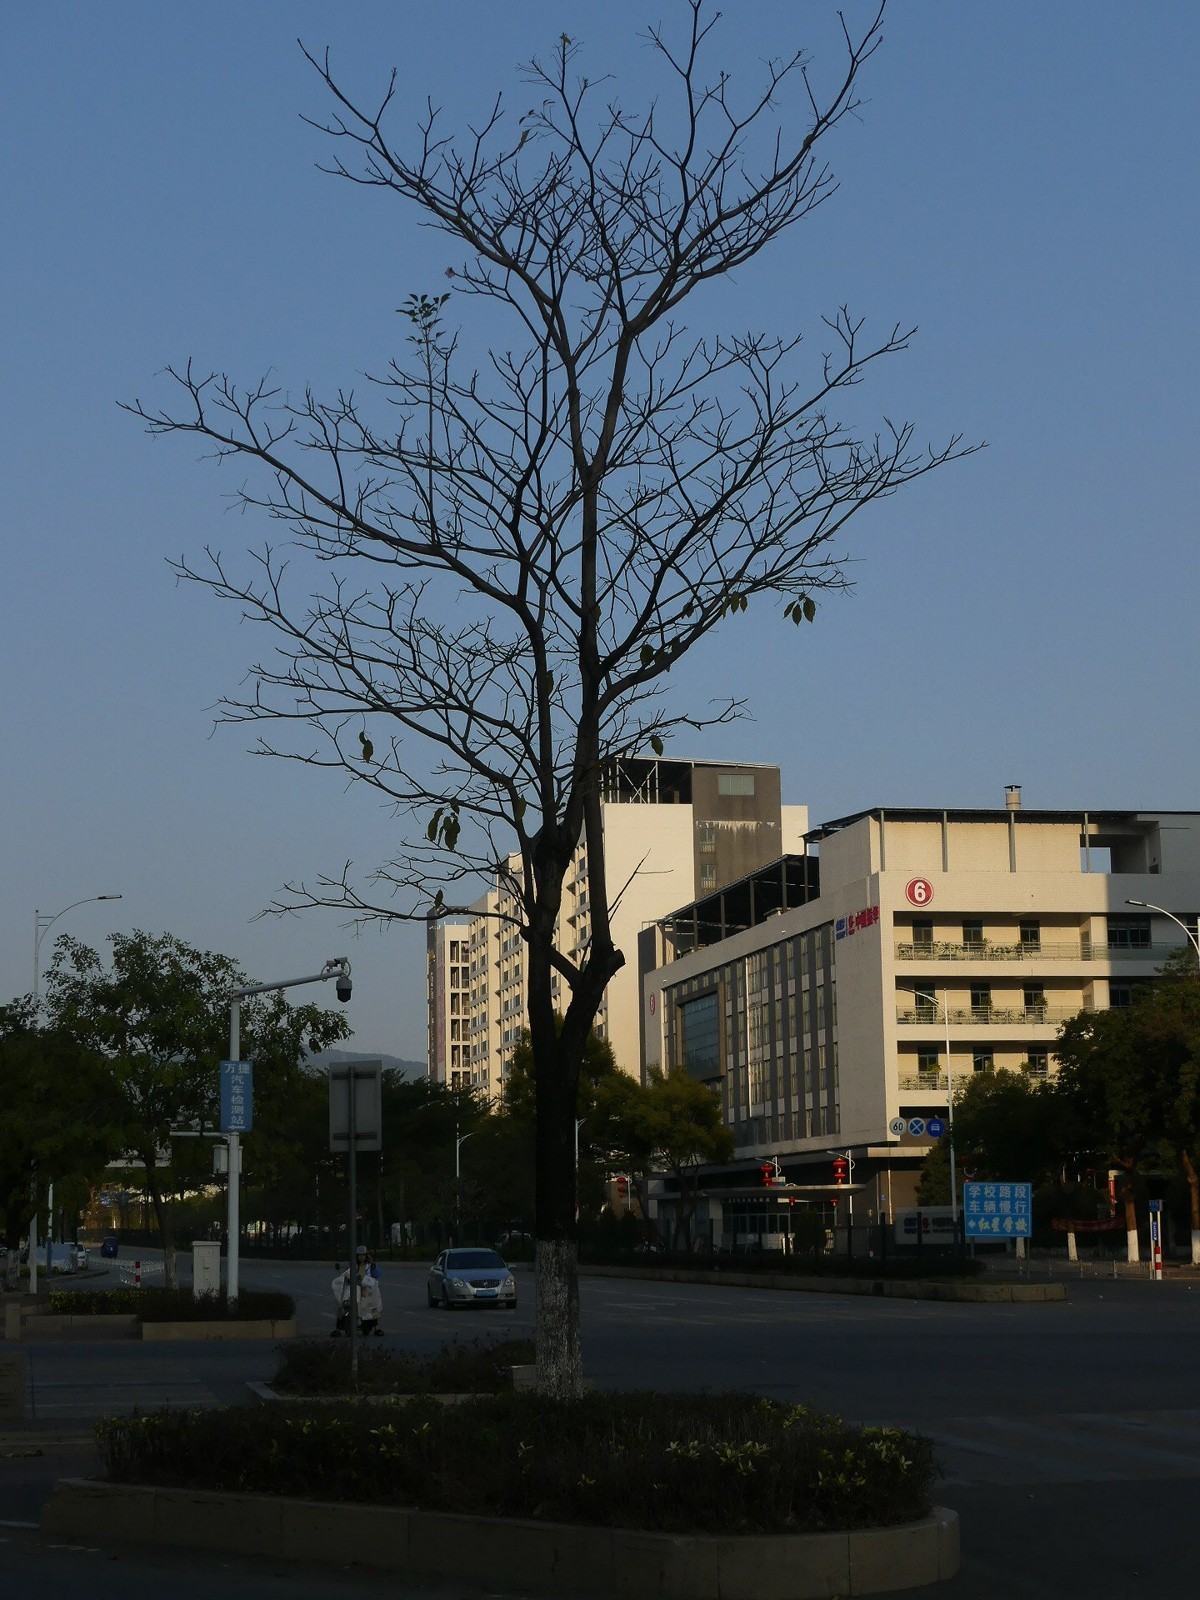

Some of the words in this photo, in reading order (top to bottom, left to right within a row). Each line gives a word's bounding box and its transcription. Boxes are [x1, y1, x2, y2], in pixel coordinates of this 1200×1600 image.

[914, 881, 926, 902] 6
[224, 1063, 251, 1074] 万捷
[231, 1075, 245, 1125] 汽车检测站
[893, 1122, 903, 1131] 60
[968, 1185, 1027, 1198] 学校路段
[968, 1200, 1027, 1213] 车辆慢行
